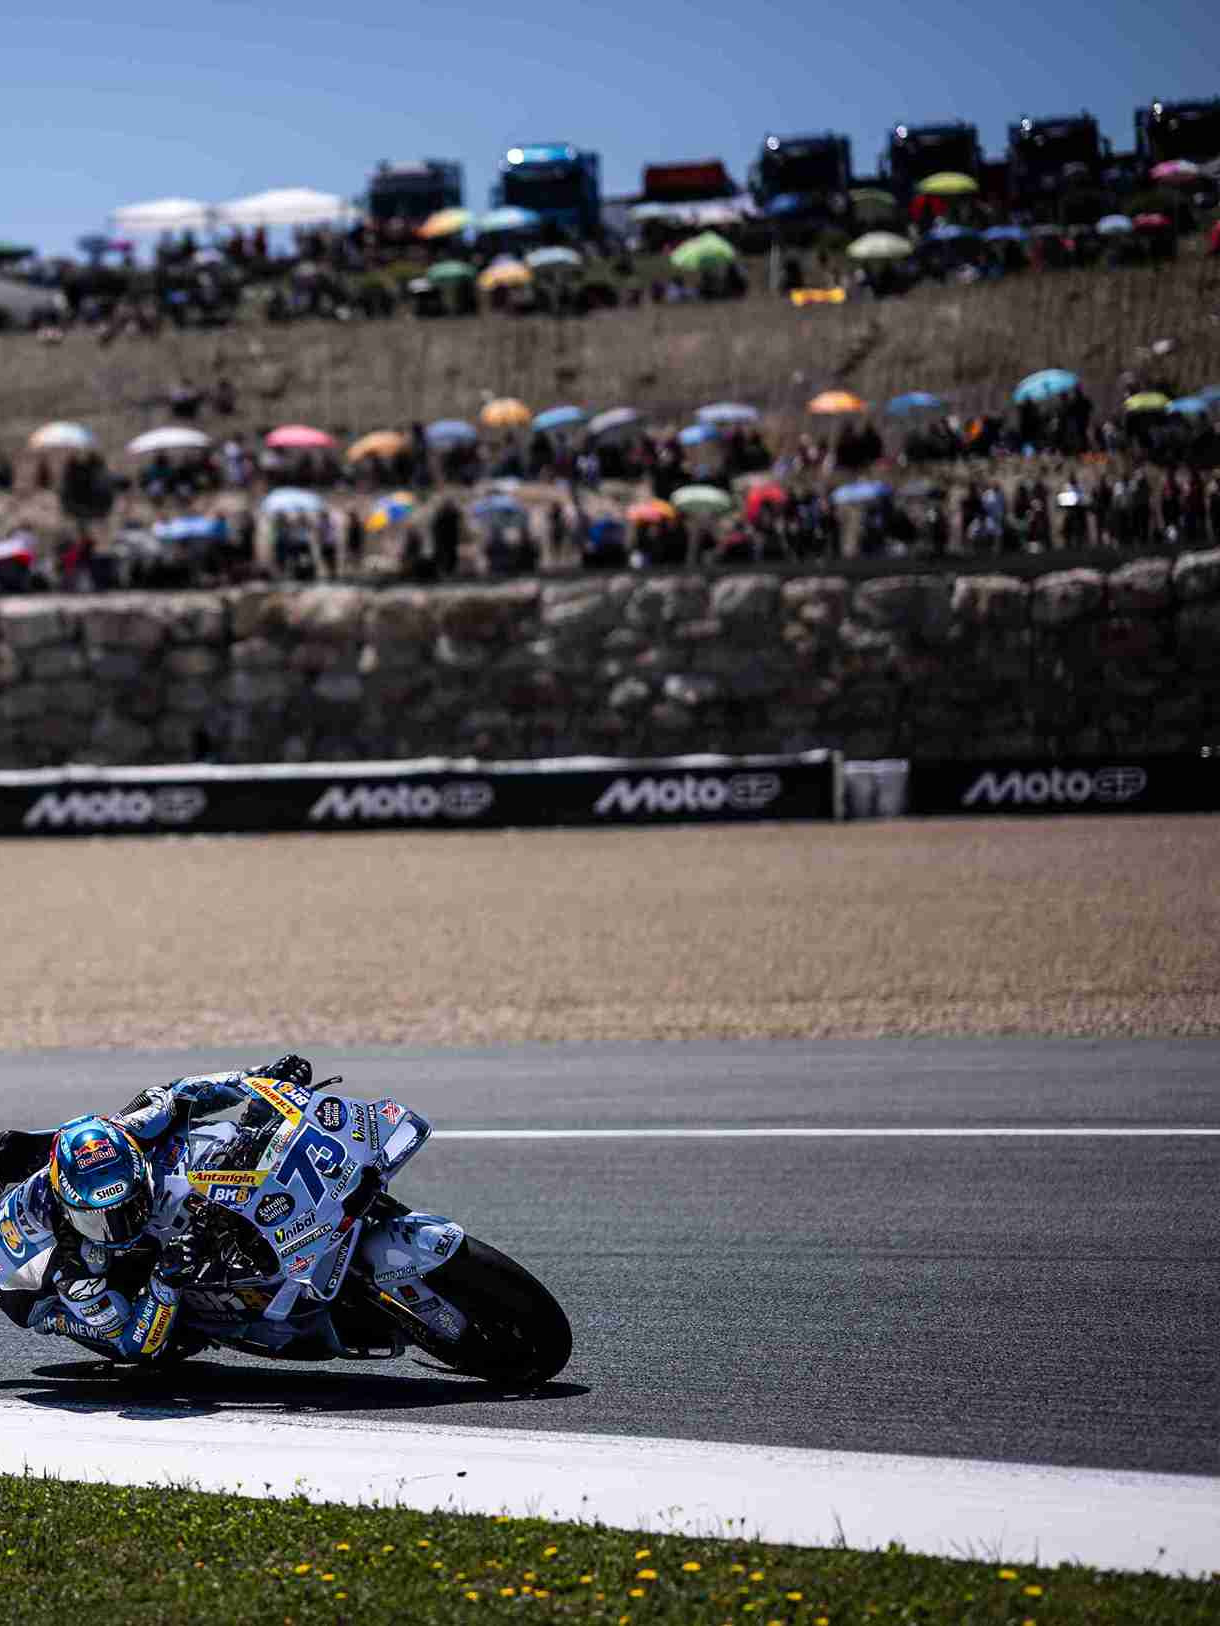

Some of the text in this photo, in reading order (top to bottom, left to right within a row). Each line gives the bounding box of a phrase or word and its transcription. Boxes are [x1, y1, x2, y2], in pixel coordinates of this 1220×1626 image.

[76, 1145, 117, 1170] Red Bull
[275, 1121, 348, 1211] 73
[193, 1172, 257, 1184] Antangin
[96, 1183, 125, 1201] SHOEI
